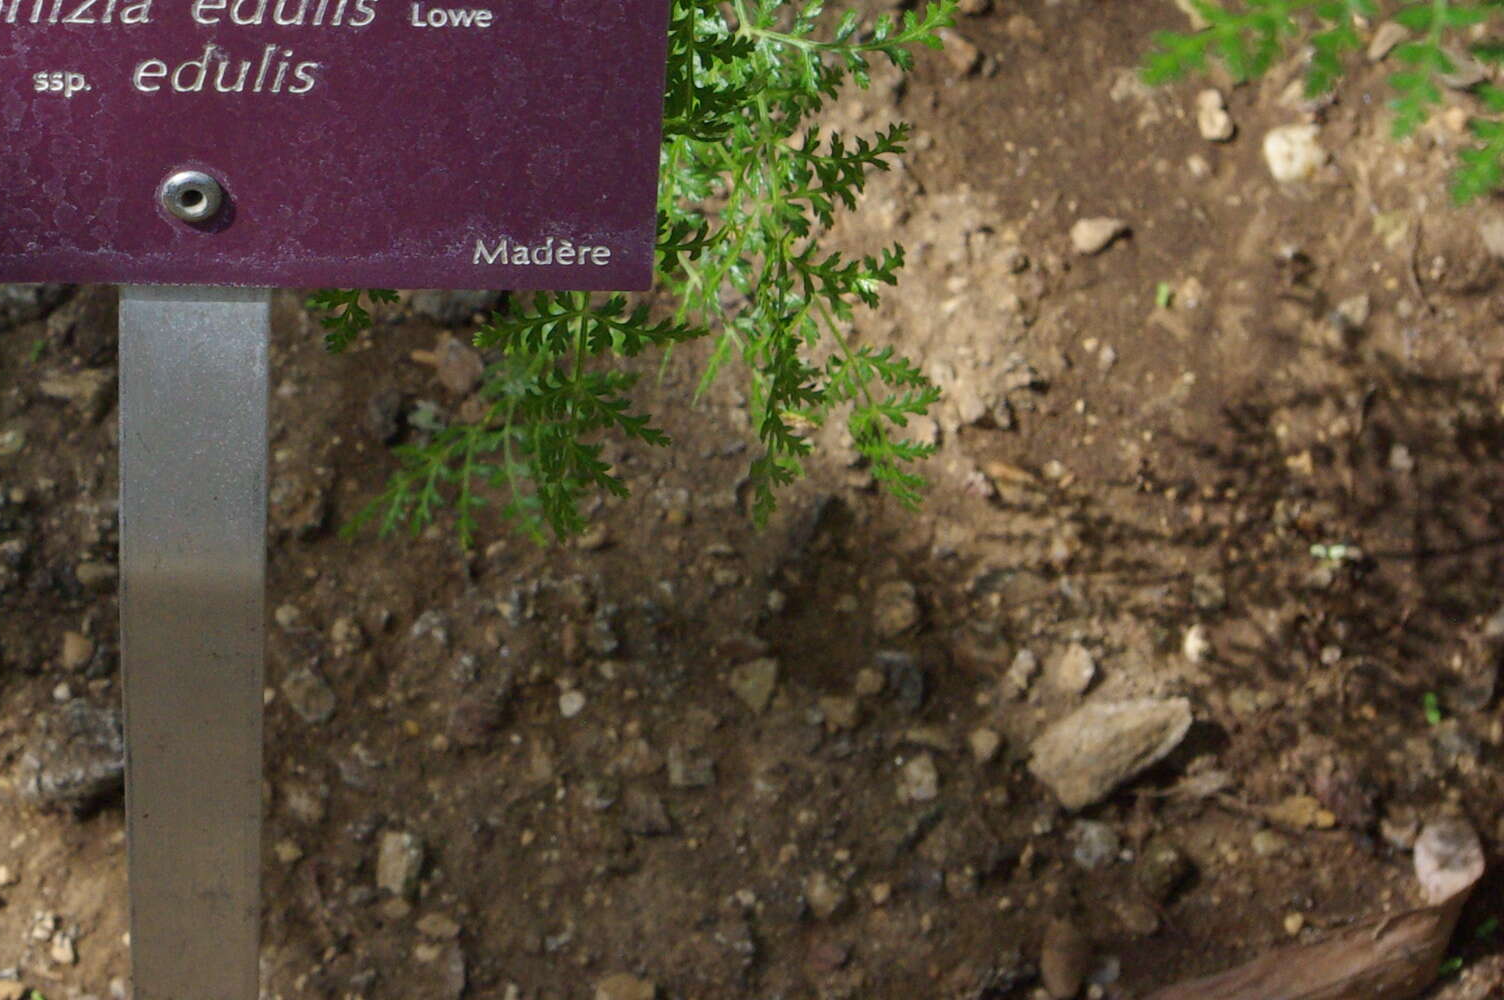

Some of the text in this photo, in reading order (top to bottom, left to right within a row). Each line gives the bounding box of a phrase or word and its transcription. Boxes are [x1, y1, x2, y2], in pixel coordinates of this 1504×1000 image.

[411, 1, 494, 29] Lowe
[32, 43, 323, 98] ssp. edulis
[472, 236, 612, 266] Madère
